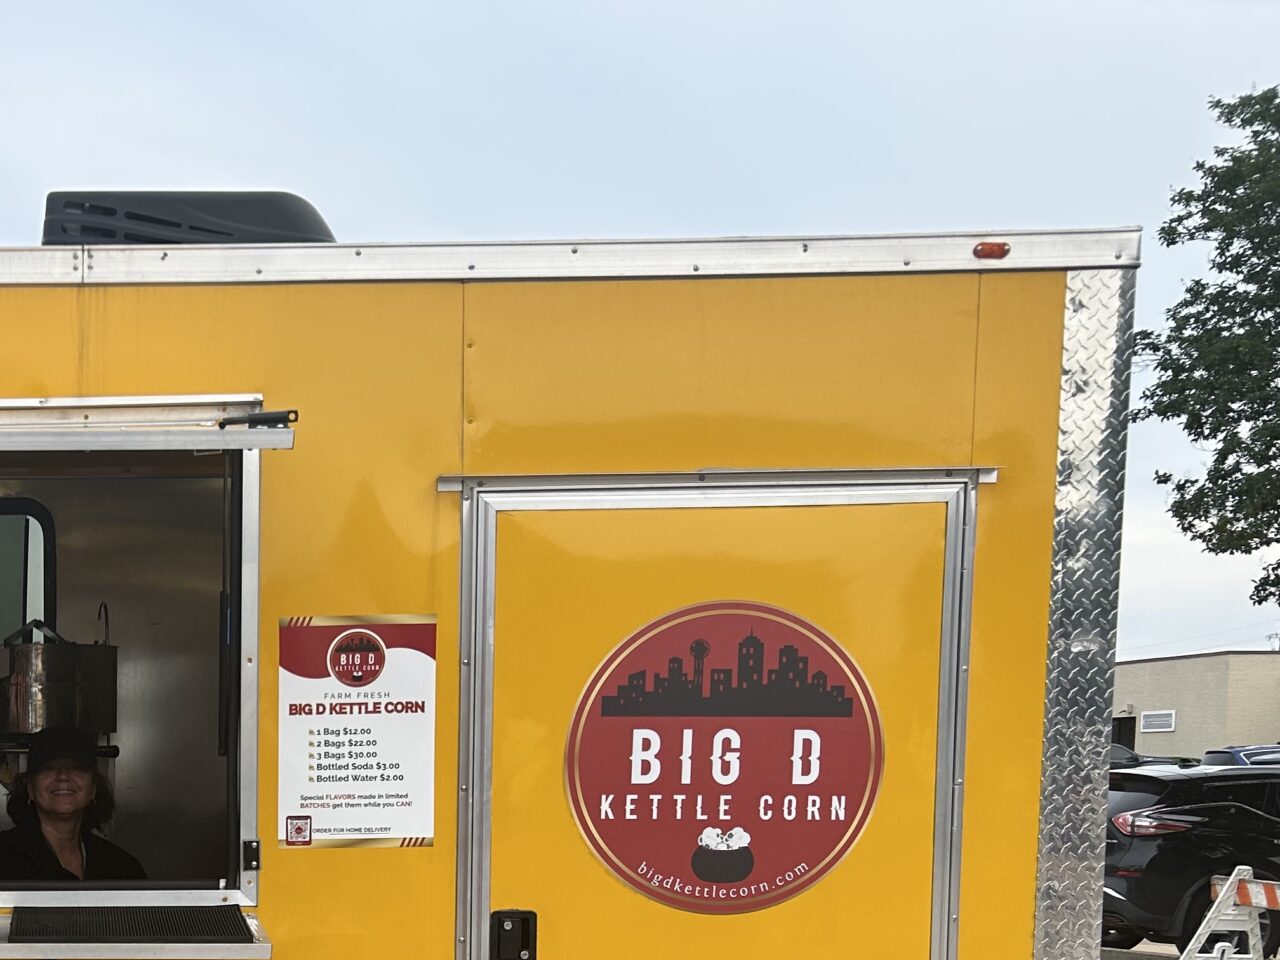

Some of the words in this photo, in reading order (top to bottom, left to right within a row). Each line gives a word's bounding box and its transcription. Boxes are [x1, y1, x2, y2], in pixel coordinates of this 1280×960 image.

[340, 653, 361, 665] BIG
[368, 653, 375, 665] D
[288, 703, 313, 716] BIG
[316, 703, 326, 715] D
[329, 702, 381, 715] KETTLE
[384, 701, 426, 714] CORN
[323, 728, 340, 737] Bag
[342, 726, 372, 735] $12.00
[323, 739, 346, 749] Bags
[347, 738, 377, 747] $22.00
[323, 751, 346, 760] Bags
[347, 750, 377, 760] $30.00
[628, 728, 741, 785] BIG
[790, 728, 821, 785] D
[351, 762, 374, 770] Soda
[376, 761, 400, 771] $3.00
[316, 774, 349, 782] Bottled
[351, 774, 378, 782] Water
[379, 773, 404, 782] $2.00
[600, 794, 732, 820] KETTLE
[759, 795, 847, 821] CORN
[637, 860, 809, 899] bigdkettlecorn.com
